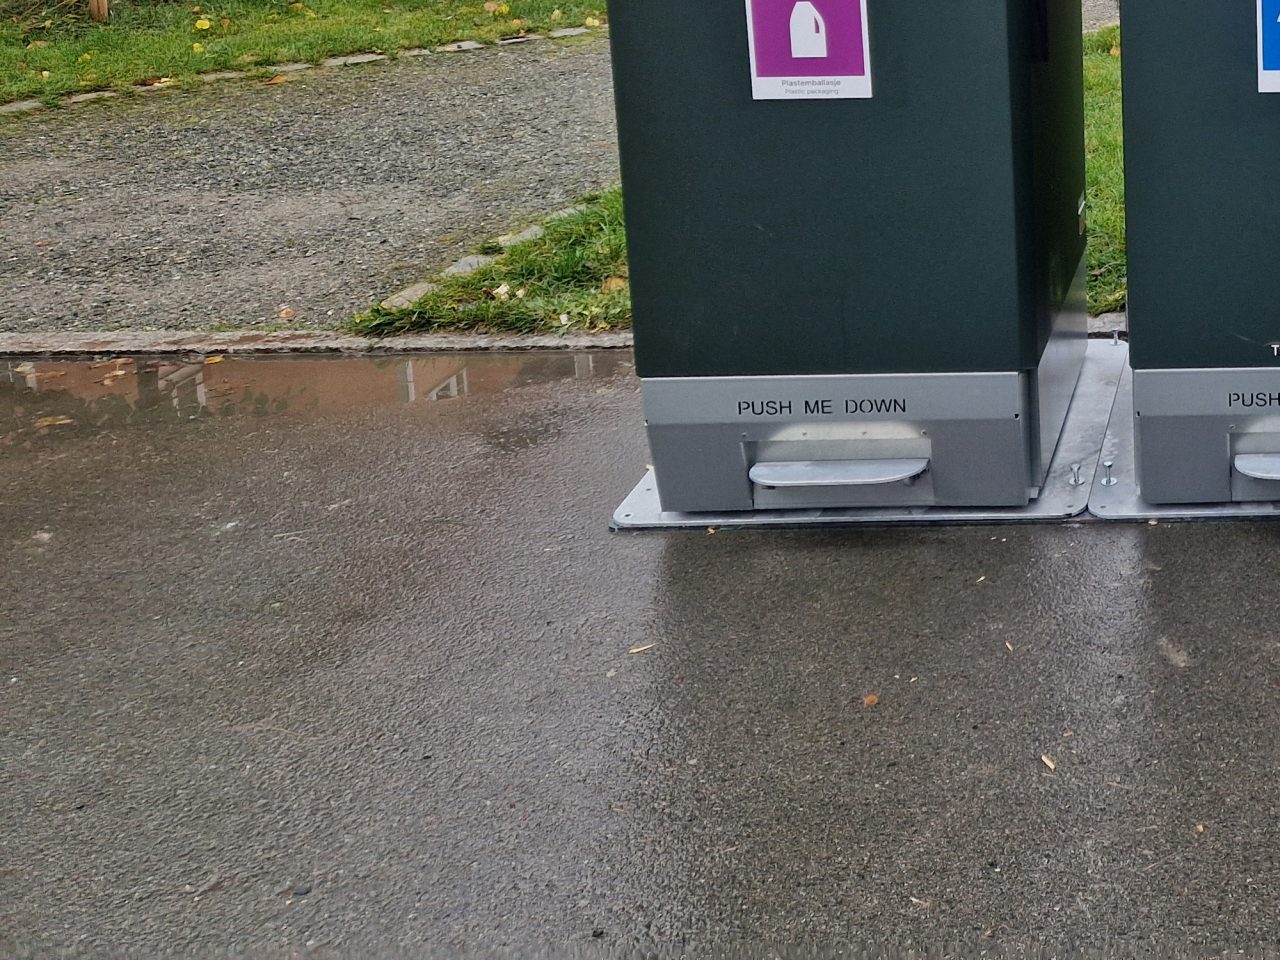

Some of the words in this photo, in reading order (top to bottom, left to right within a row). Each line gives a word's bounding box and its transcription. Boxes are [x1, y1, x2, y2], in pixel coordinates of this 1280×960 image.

[781, 79, 841, 87] Plastemballasje
[738, 400, 792, 415] PUSH
[804, 399, 834, 414] ME
[845, 398, 906, 414] DOWN
[1228, 392, 1280, 407] PUSH
